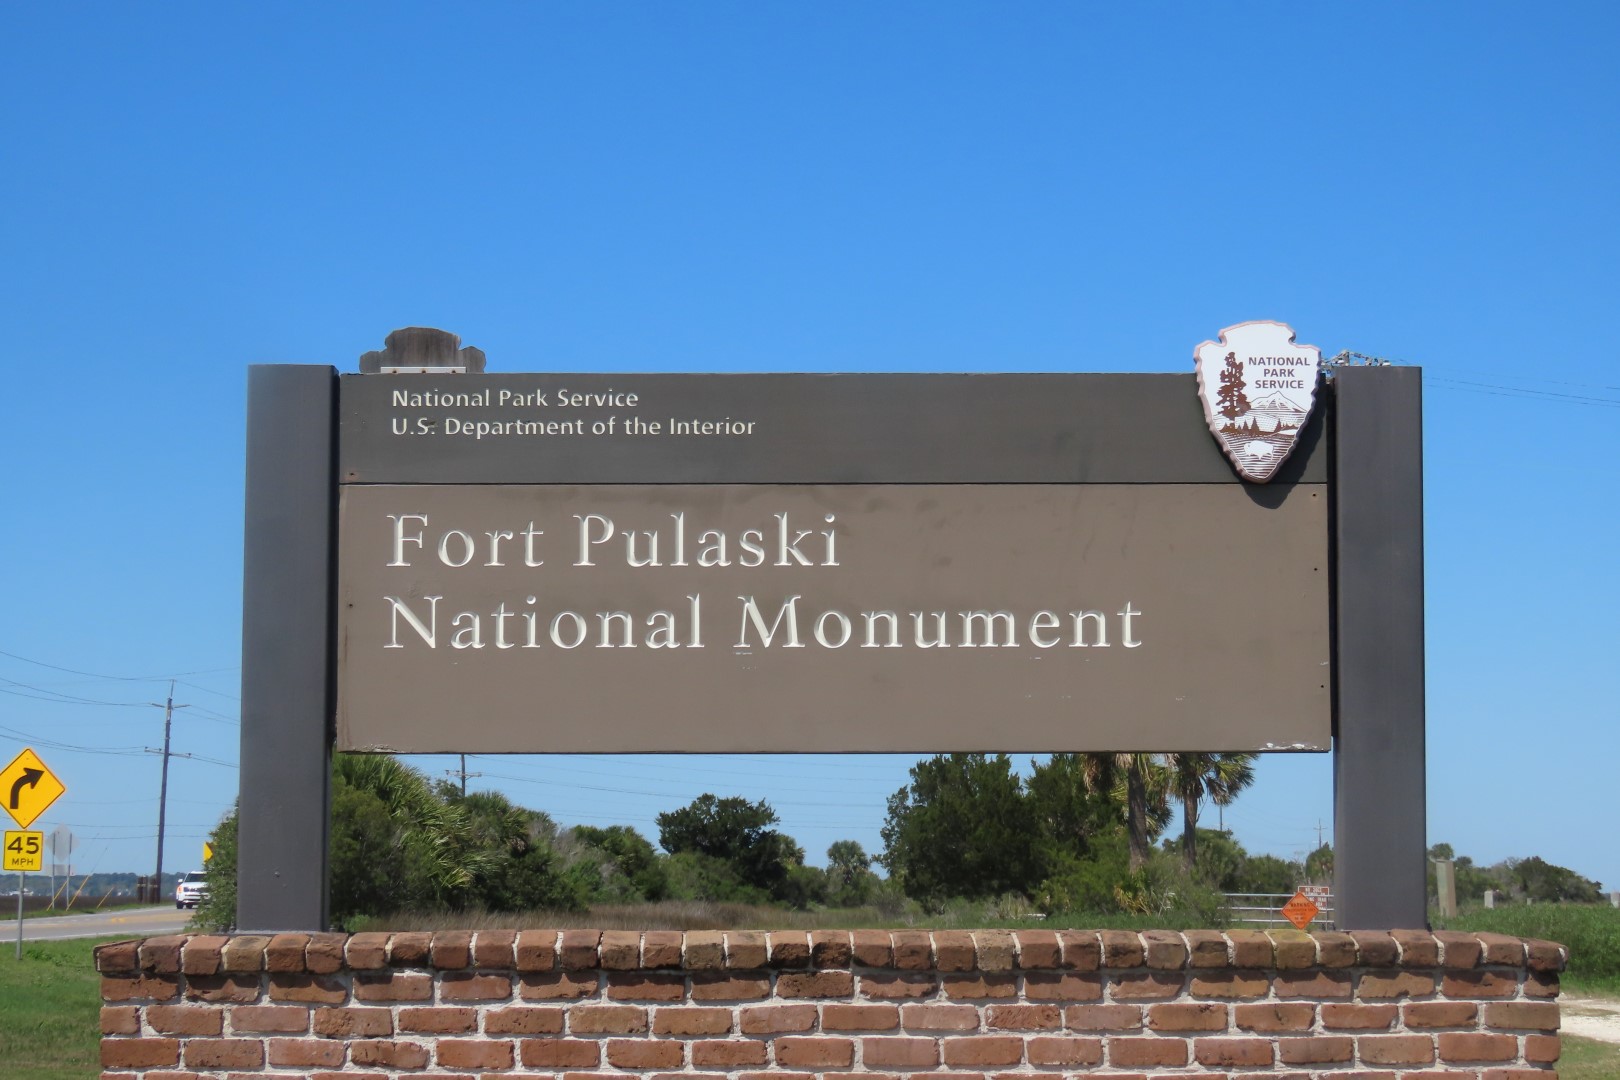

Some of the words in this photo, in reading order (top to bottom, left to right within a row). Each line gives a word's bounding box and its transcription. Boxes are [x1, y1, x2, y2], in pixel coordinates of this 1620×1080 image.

[1248, 356, 1310, 366] NATIONAL
[1263, 368, 1295, 378] PARK
[1254, 379, 1304, 389] SERVICE
[391, 388, 490, 407] National
[498, 389, 549, 407] Park
[557, 389, 639, 407] Service
[391, 417, 436, 436] U.S.
[444, 417, 585, 440] Department
[591, 416, 616, 435] of
[623, 416, 662, 435] the
[669, 417, 756, 435] Interior
[385, 513, 544, 568] Fort
[572, 511, 840, 568] Pulaski
[383, 592, 705, 649] National
[732, 594, 1143, 649] Monument
[7, 836, 39, 854] 45
[12, 858, 34, 866] MPH
